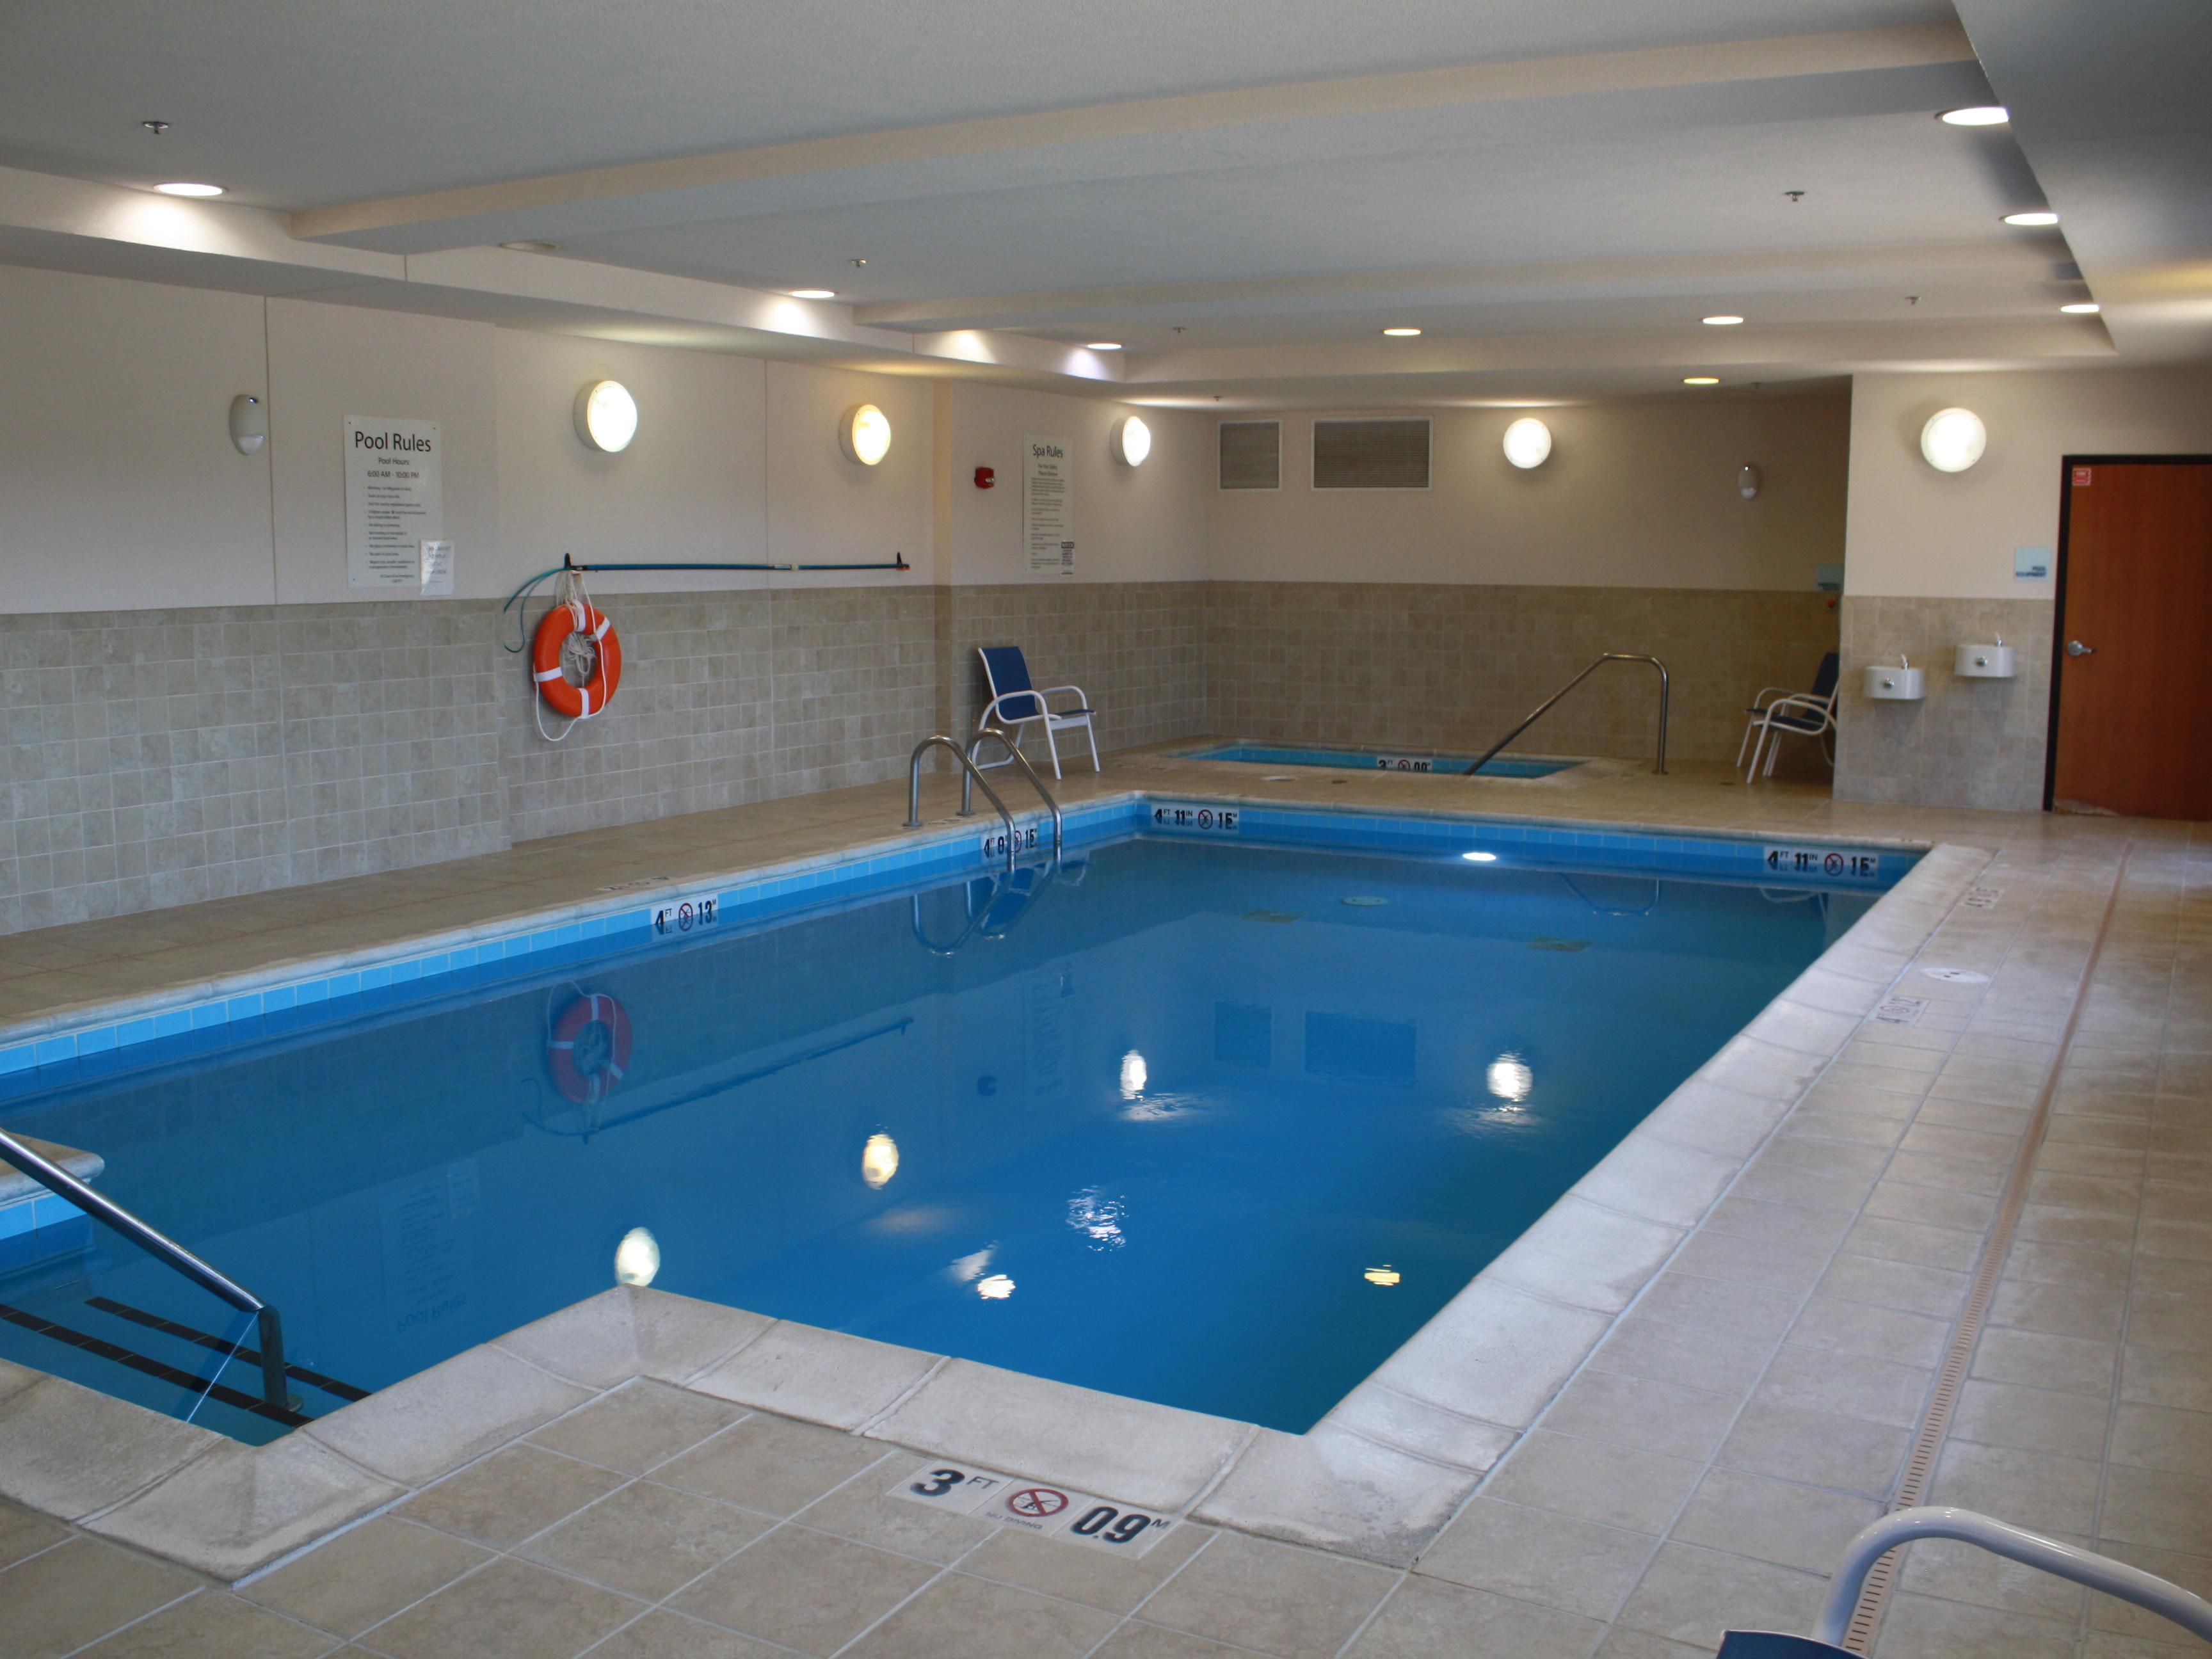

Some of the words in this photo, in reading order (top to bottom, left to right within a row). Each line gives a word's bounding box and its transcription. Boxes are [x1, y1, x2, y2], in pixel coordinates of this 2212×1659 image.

[355, 431, 388, 449] Pool
[393, 433, 431, 452] Rules
[1032, 444, 1045, 459] Spa
[1046, 445, 1063, 458] Rules
[378, 457, 391, 465] Pool
[665, 908, 673, 917] FT
[910, 1469, 965, 1496] 3
[966, 1476, 1000, 1489] FT
[1070, 1506, 1151, 1544] 0.9
[1151, 1518, 1172, 1529] M
[1003, 1516, 1043, 1529] DIVING
